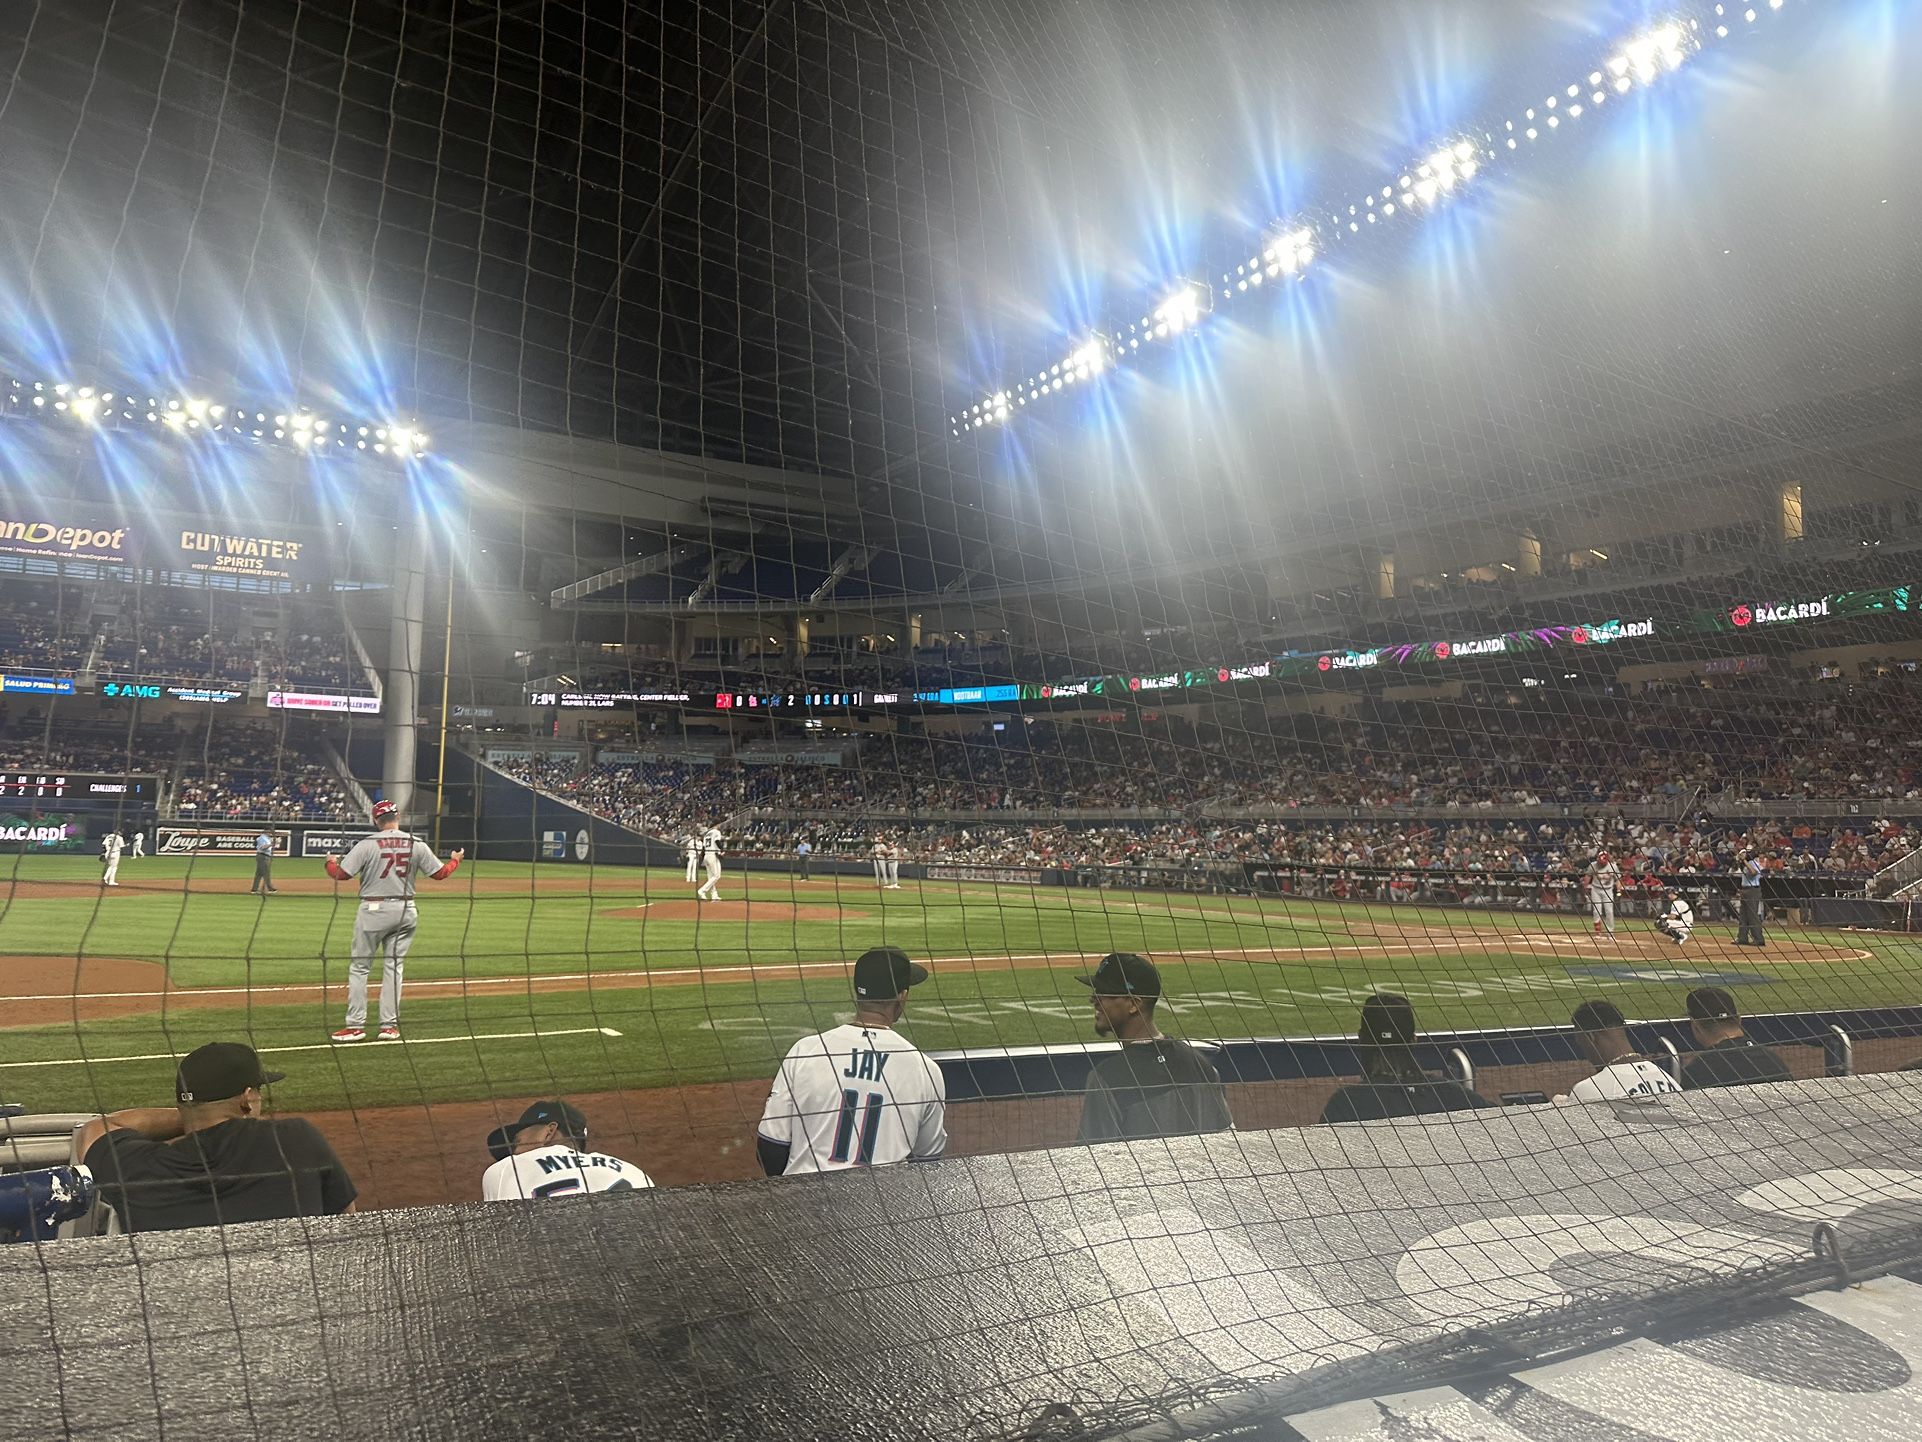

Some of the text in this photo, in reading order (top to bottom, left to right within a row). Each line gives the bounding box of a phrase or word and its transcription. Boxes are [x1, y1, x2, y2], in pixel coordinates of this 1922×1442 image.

[181, 531, 298, 560] CUTWATER
[215, 555, 264, 568] SPIRITS
[1755, 596, 1830, 623] BACARDÍ
[1452, 634, 1506, 656] BACARDÍ
[4, 680, 32, 688] SALUD
[120, 684, 160, 698] AMG
[531, 693, 556, 705] 7:04
[787, 695, 794, 706] 2
[18, 786, 25, 795] 2
[160, 831, 210, 852] Loupe
[216, 835, 255, 843] BASEBALL
[379, 852, 412, 879] 75
[843, 1047, 890, 1083] JAY
[828, 1088, 884, 1165] 11
[535, 1154, 623, 1175] MYERS
